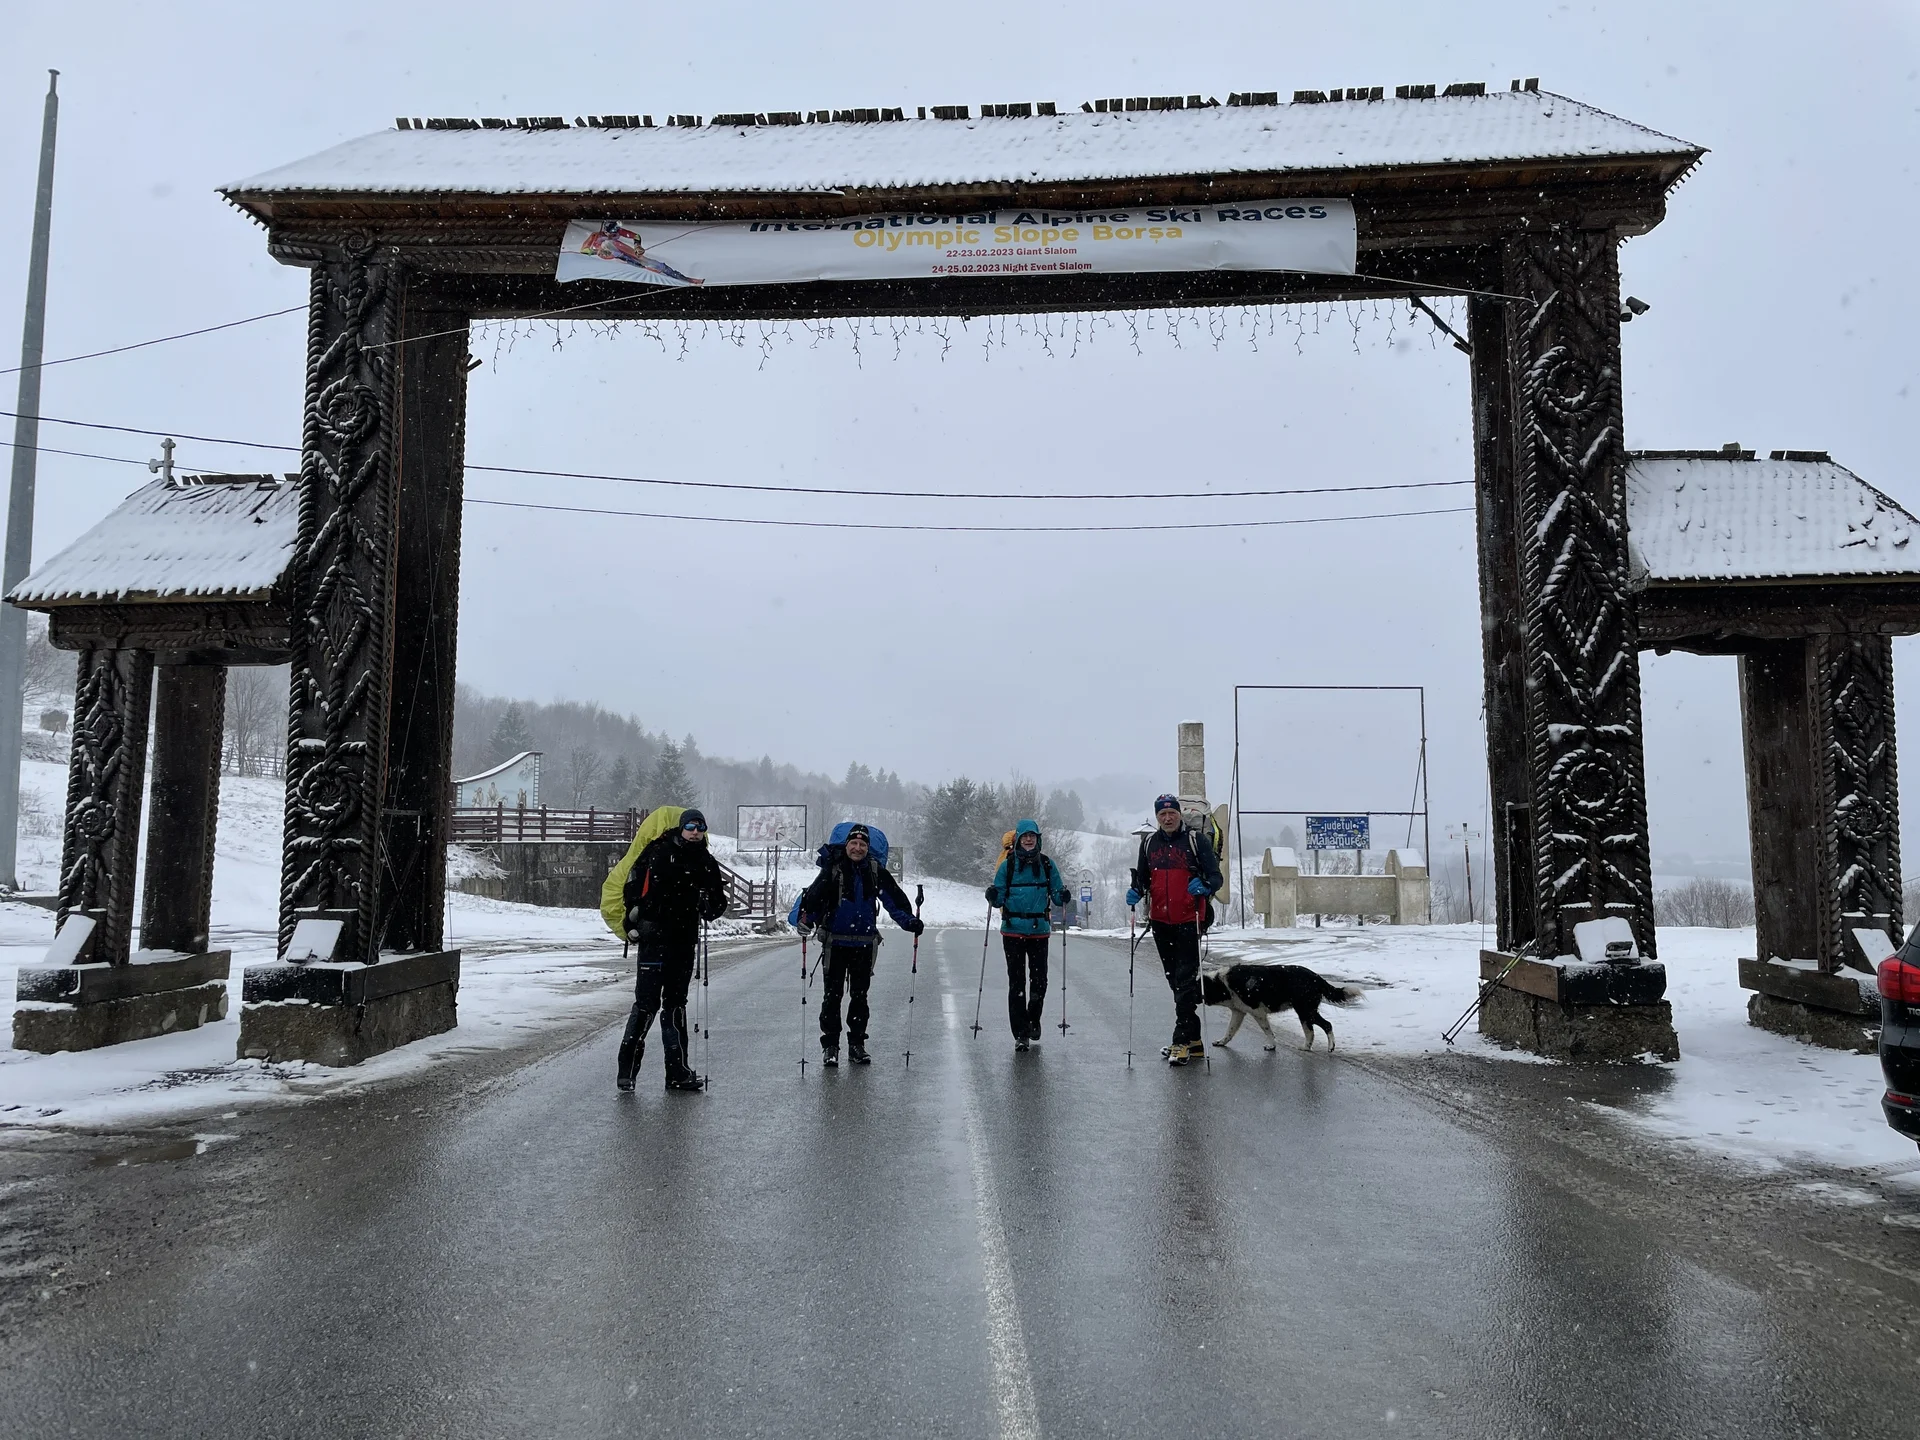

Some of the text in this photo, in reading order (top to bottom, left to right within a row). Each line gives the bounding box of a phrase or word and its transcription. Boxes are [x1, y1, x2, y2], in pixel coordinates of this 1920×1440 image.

[749, 205, 1328, 232] International Alpine Ski Races
[853, 225, 1183, 251] Olympic Slope Borșa
[946, 247, 1077, 258] 22-23.02.2023 Giant Slalom
[932, 261, 1092, 274] 24-25.02.2023 Night Event Slalom
